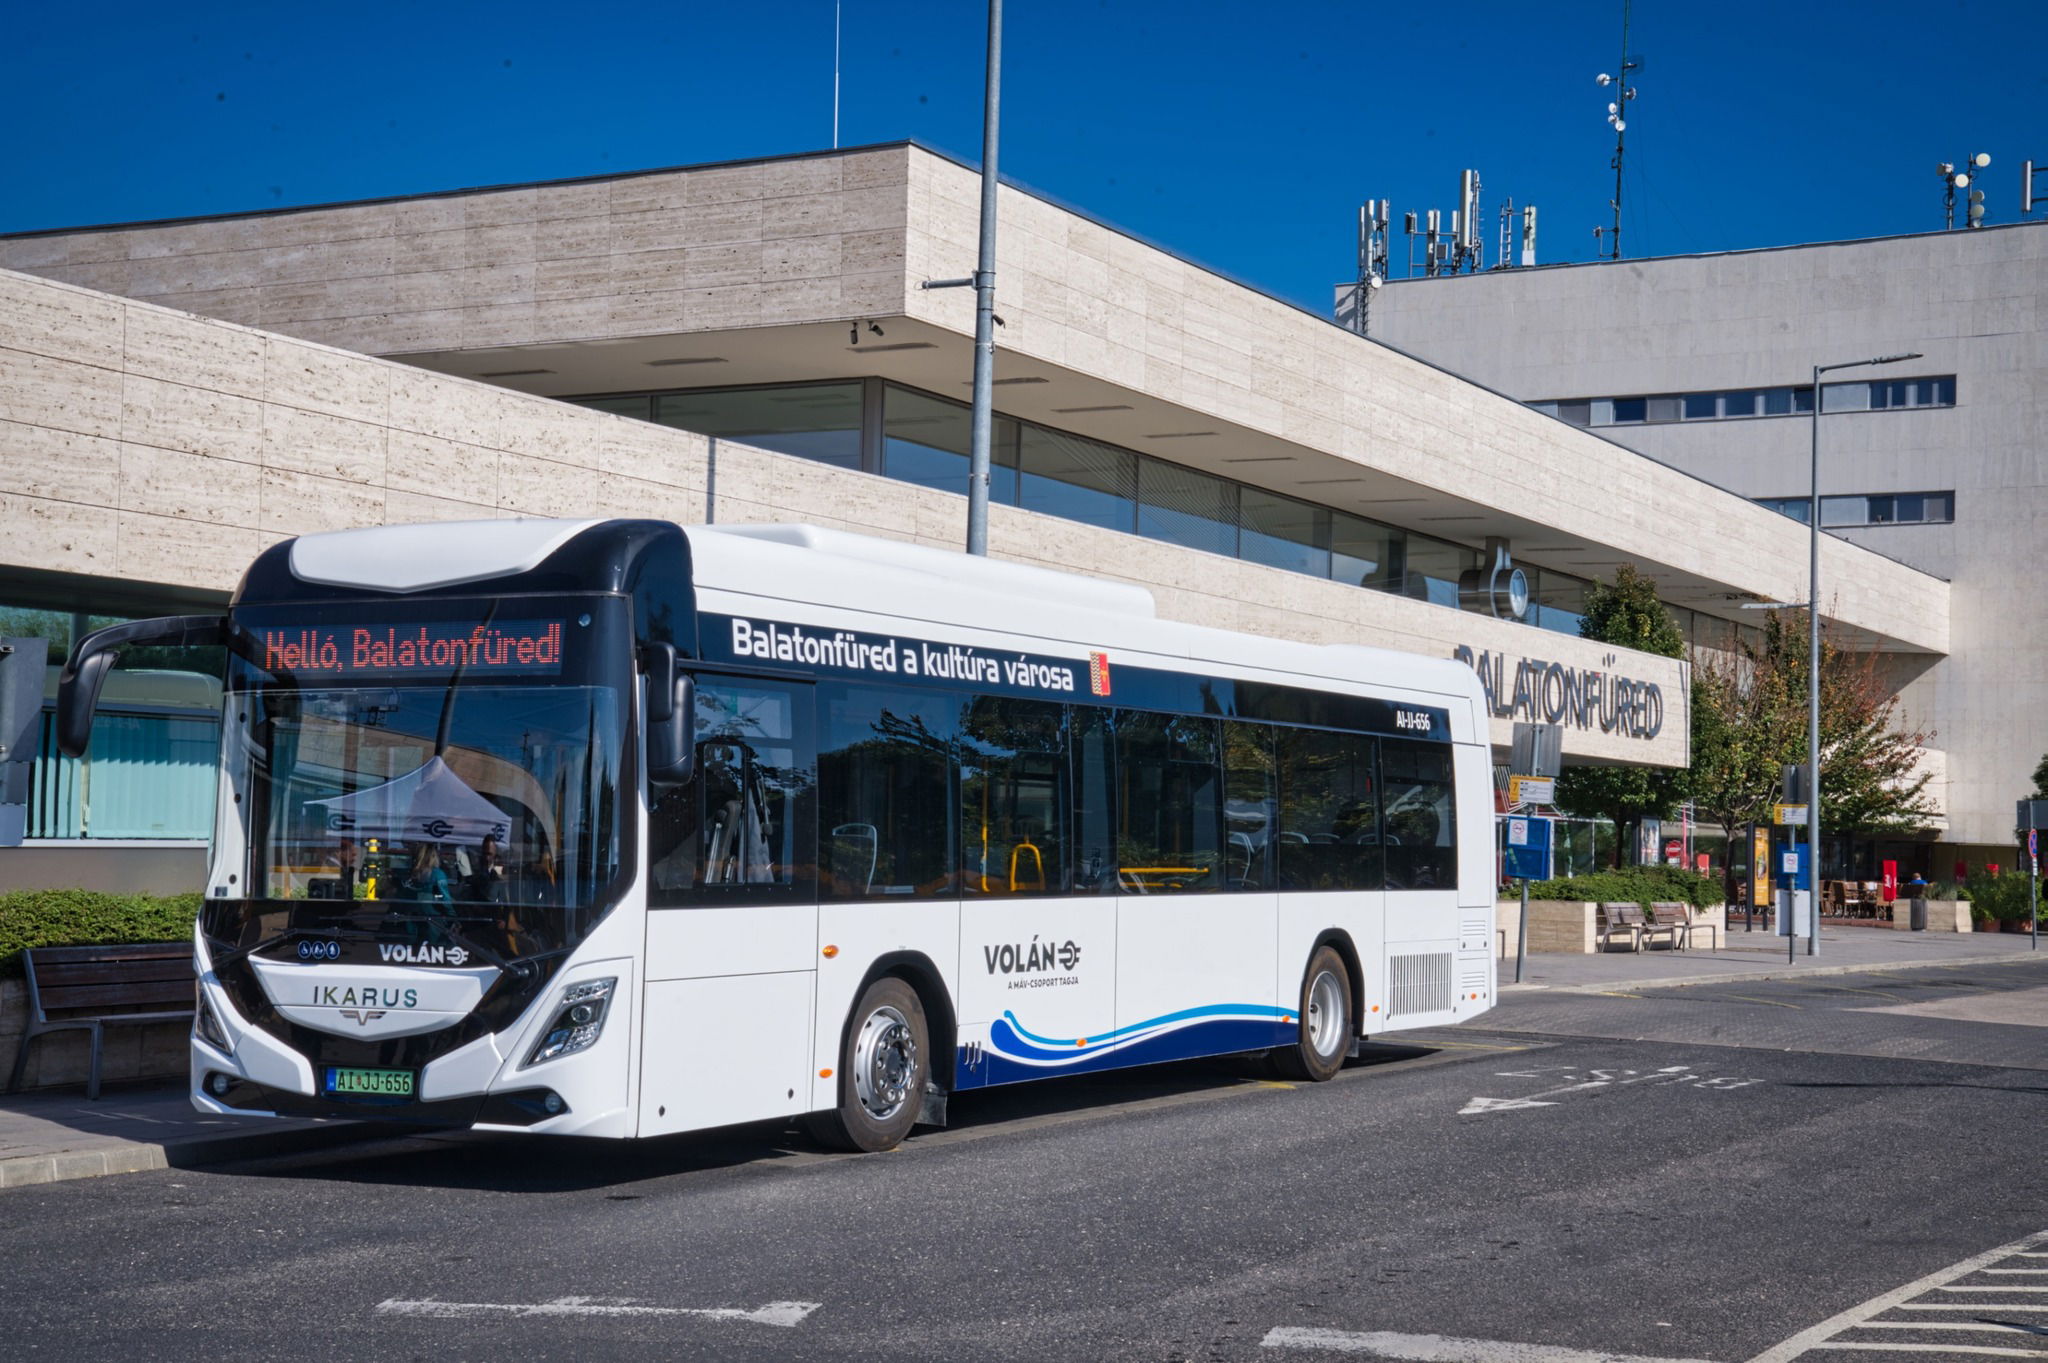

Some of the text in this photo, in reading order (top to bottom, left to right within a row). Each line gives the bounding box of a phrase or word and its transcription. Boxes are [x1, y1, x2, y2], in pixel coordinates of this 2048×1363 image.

[264, 622, 561, 673] Helló, Balatonfüred!
[731, 617, 1075, 692] Balatonfüred a kultúra városa
[1396, 709, 1431, 731] AI-JJ-656
[378, 940, 445, 965] VOLÁN
[983, 934, 1056, 975] VOLÁN
[1007, 975, 1079, 990] A MÁV-CSOPORT TAGJA
[313, 985, 419, 1008] IKARUS
